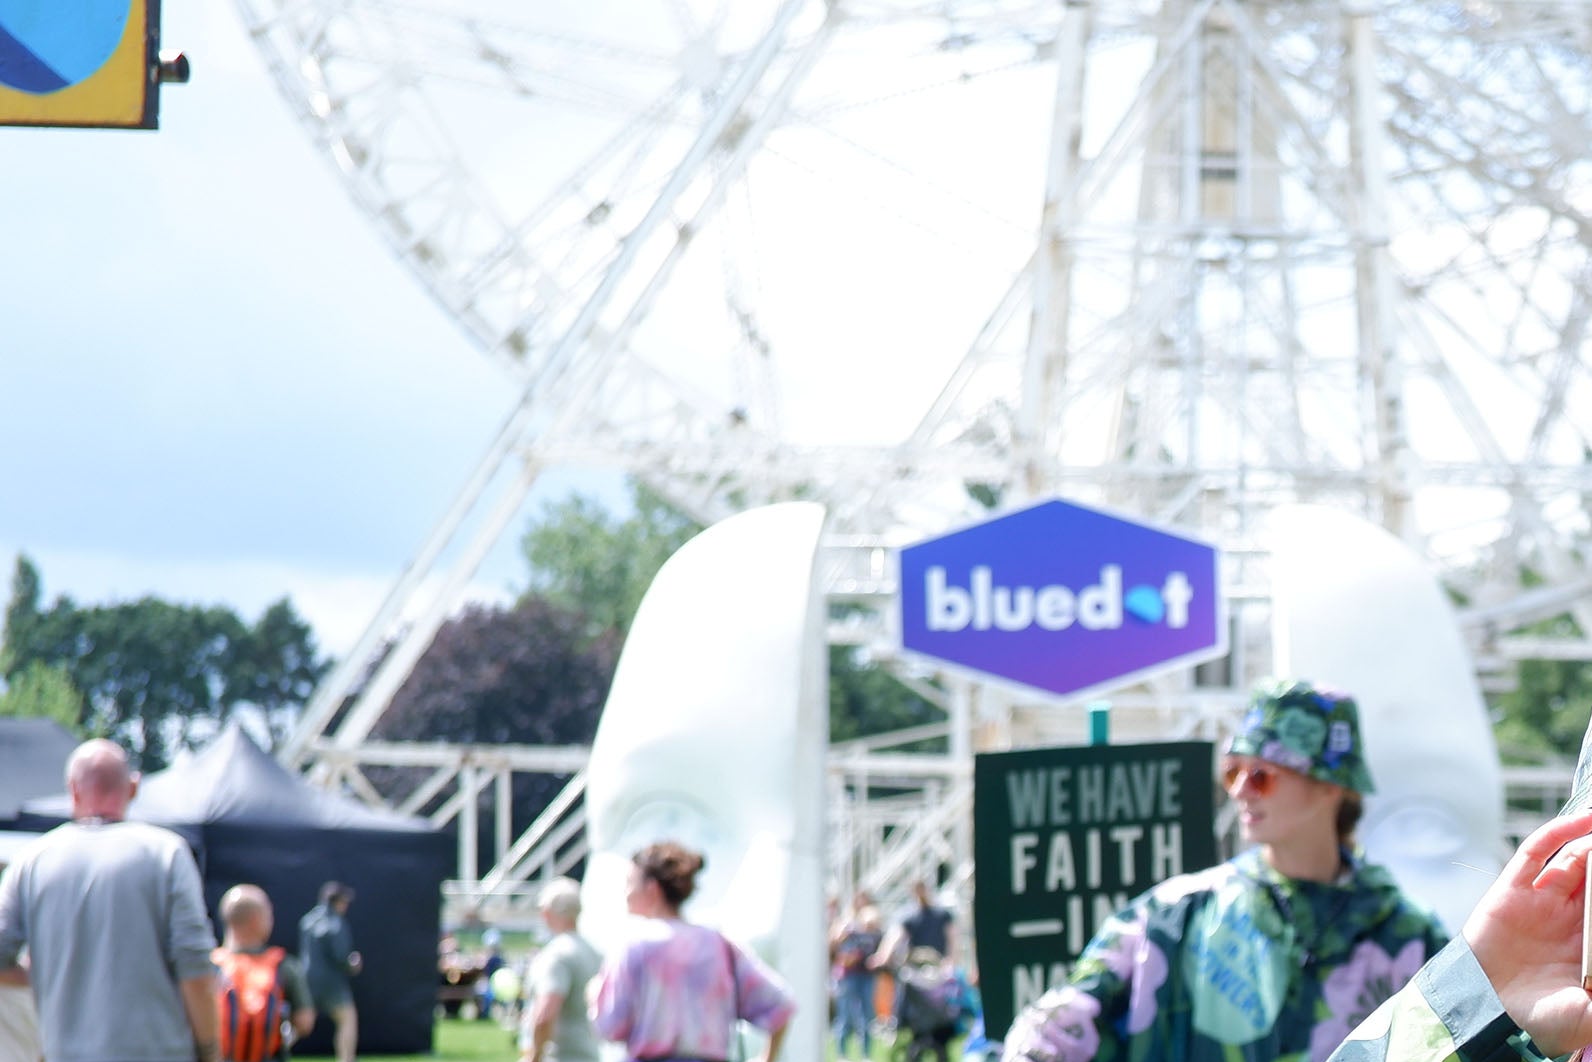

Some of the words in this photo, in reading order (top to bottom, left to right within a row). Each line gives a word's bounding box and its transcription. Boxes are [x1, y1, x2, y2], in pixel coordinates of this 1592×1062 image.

[1008, 767, 1071, 828] WE
[1077, 759, 1182, 822] HAVE
[1010, 823, 1183, 896] FAITH
